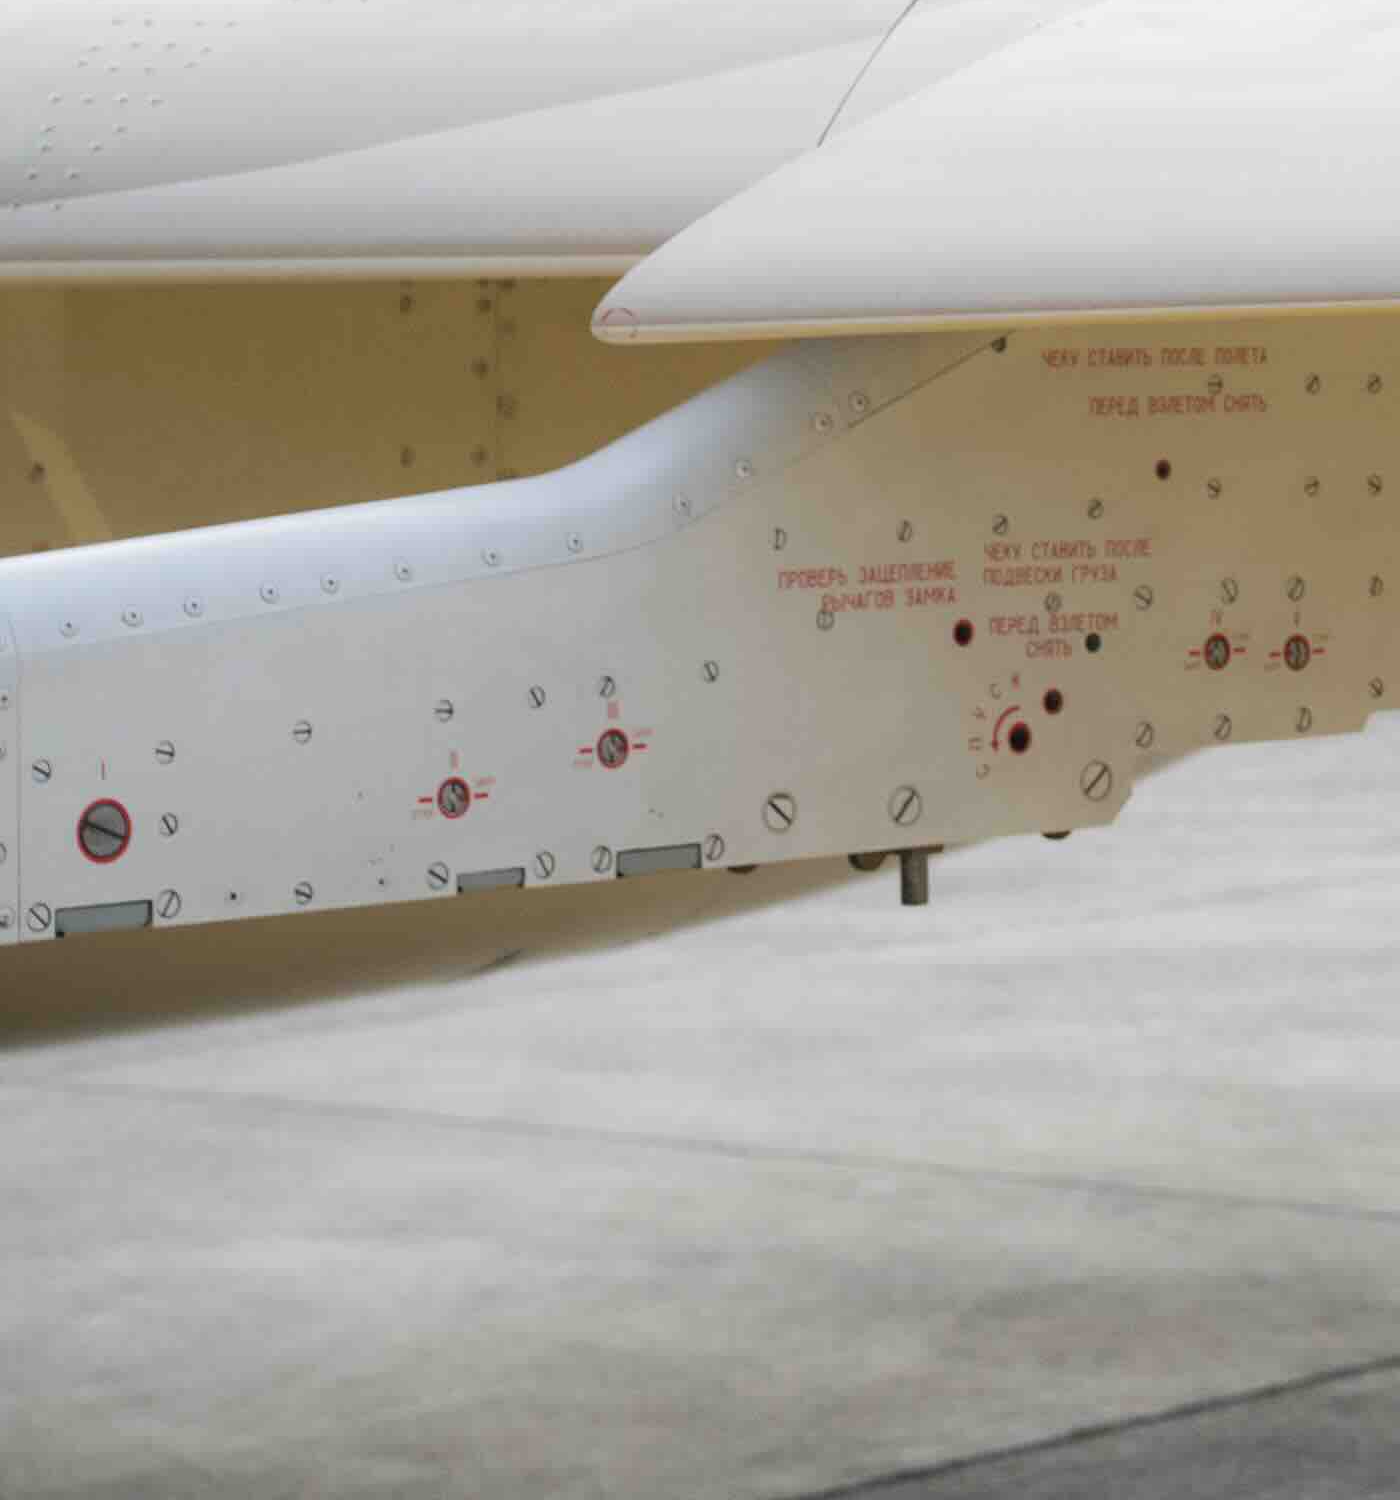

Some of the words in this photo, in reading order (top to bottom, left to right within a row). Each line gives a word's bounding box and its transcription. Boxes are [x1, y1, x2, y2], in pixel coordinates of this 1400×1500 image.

[1088, 347, 1152, 367] СТАВИТЬ
[1161, 347, 1206, 367] ПОСЛЕ
[1089, 396, 1139, 417] ПЕРЕД
[1031, 540, 1096, 560] СТАВИТЬ
[778, 568, 847, 589] ПРОВЕРЬ
[858, 561, 957, 584] ЗАЦЕПЛЕНИЕ
[1071, 564, 1118, 583] ГРУЗА
[905, 587, 957, 606] ЗАМКА
[989, 614, 1040, 636] ПЕРЕД
